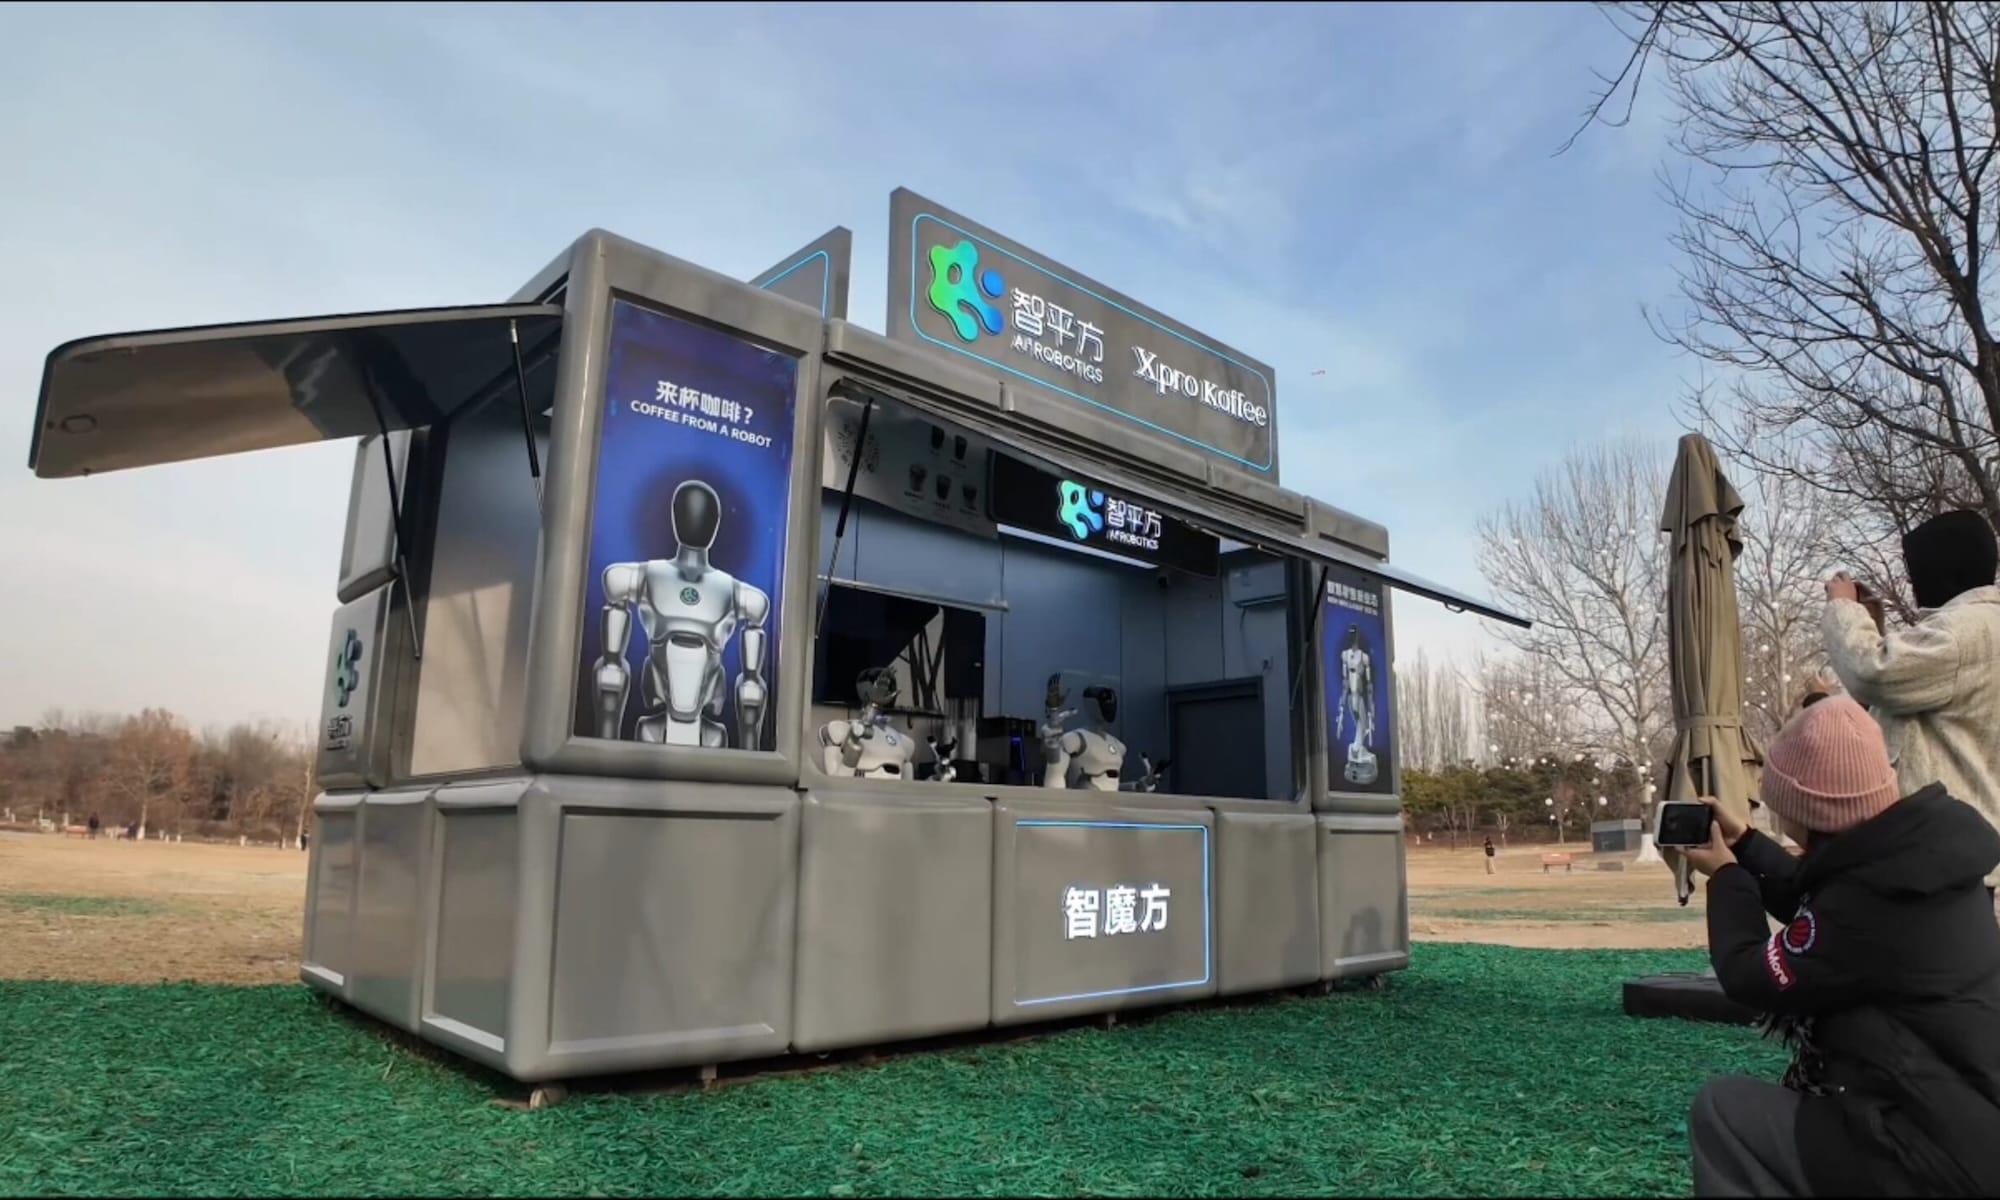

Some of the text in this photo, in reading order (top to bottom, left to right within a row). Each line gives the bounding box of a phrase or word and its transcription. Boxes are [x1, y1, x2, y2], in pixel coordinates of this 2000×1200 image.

[1012, 288, 1104, 362] 智平方
[630, 400, 772, 448] COFFEE FROM A ROBOT
[655, 380, 754, 424] 来杯咖啡？
[1107, 497, 1162, 538] 智平方
[1065, 883, 1171, 939] 智魔方
[1768, 948, 1789, 985] More
